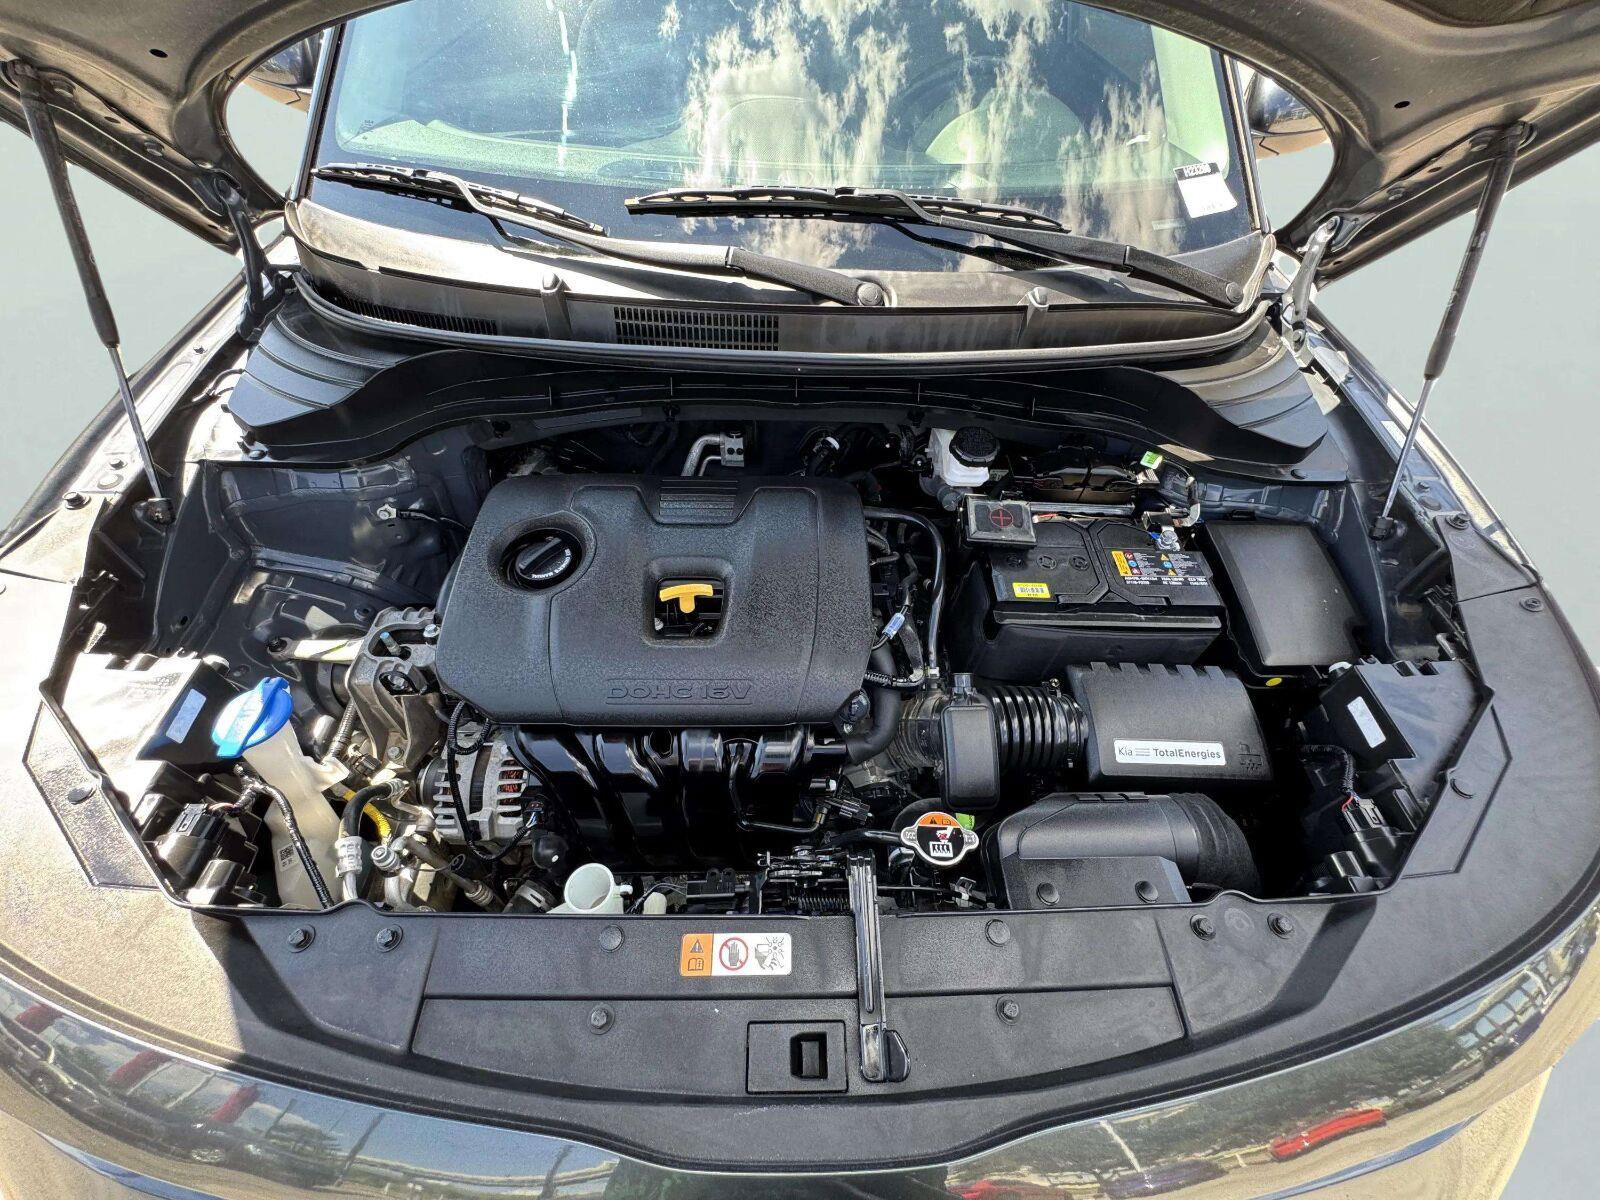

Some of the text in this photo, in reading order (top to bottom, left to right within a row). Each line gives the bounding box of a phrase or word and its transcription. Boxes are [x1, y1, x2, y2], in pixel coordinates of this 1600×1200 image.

[606, 684, 752, 700] DOHC 16V
[1119, 746, 1222, 760] Kia TotalEnergies
